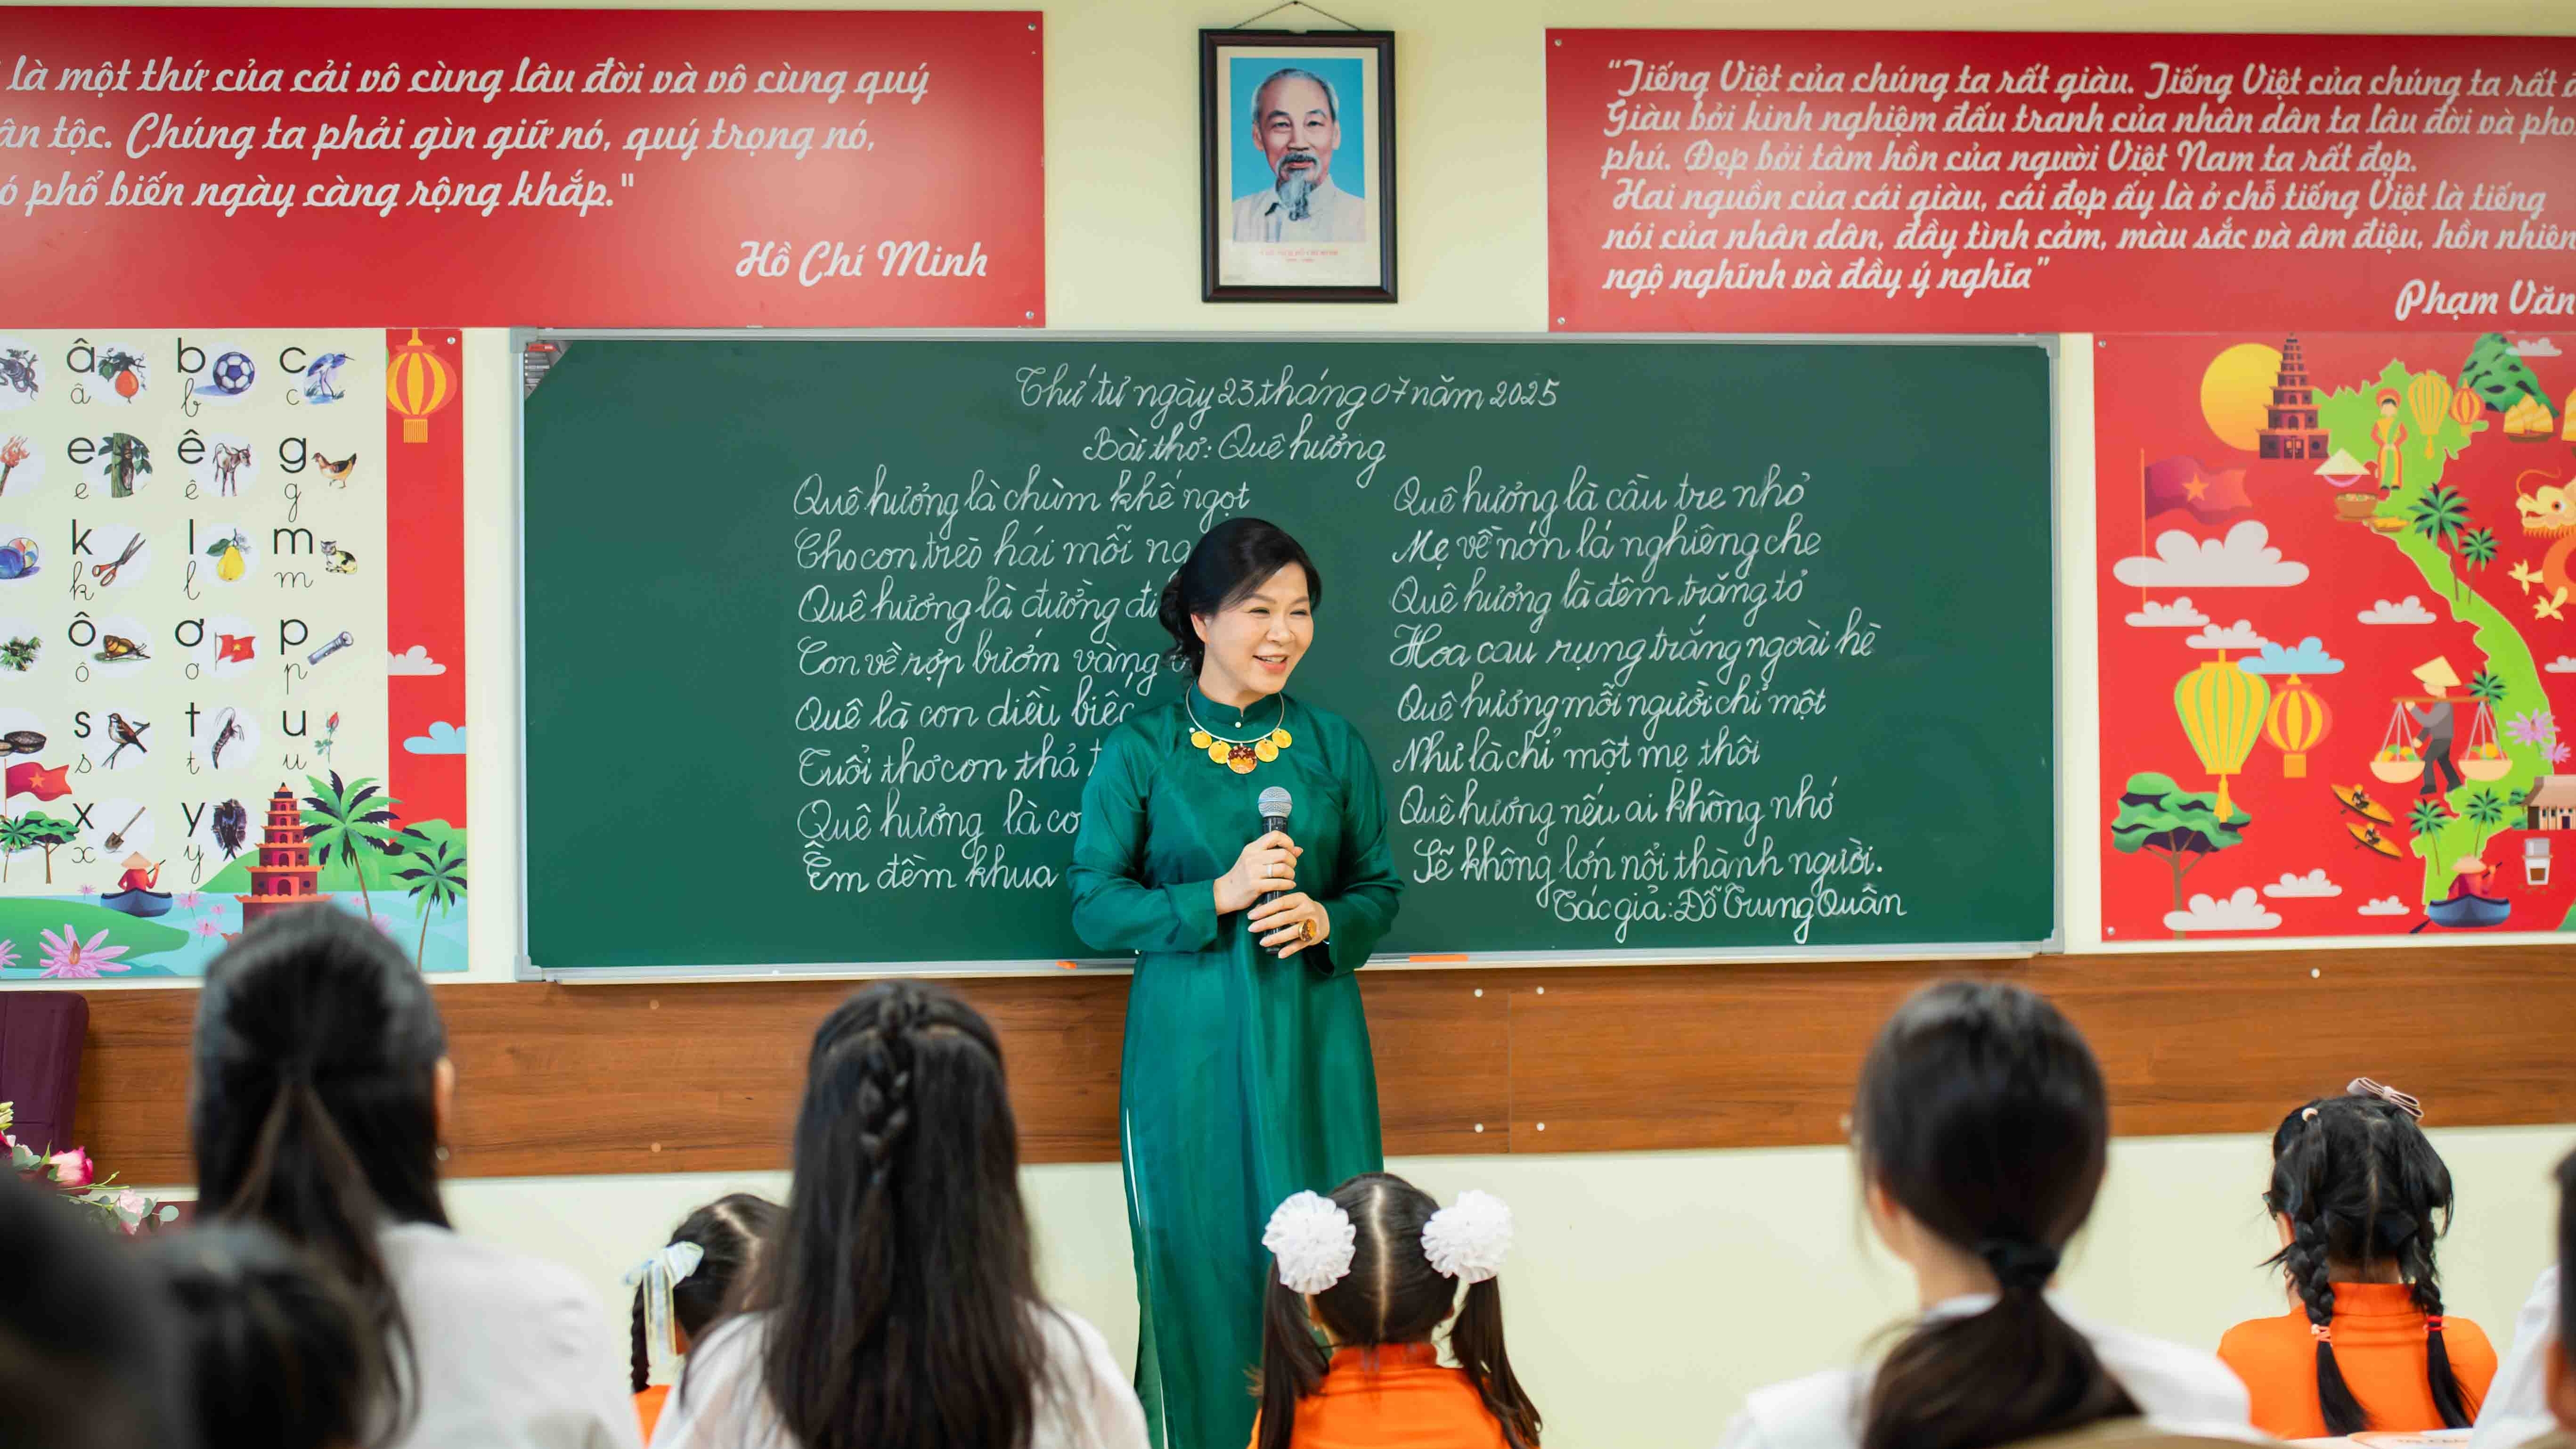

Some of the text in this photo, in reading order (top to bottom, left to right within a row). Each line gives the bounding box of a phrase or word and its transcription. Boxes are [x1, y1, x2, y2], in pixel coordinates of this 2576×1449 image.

[6, 55, 929, 105] là một thứ của cải vô cùng lâu đời và vô cùng quý
[1720, 60, 1782, 97] Việt
[1786, 63, 1845, 92] của
[1850, 62, 1949, 102] chúng
[1955, 65, 1991, 93] ta
[1997, 63, 2050, 93] rất
[2054, 66, 2134, 103] giàu.
[2144, 62, 2234, 104] Tiếng
[2242, 63, 2302, 100] Việt
[2306, 67, 2362, 95] của
[2368, 65, 2462, 105] chúng
[2467, 69, 2501, 96] ta
[2506, 68, 2557, 97] rất
[0, 113, 874, 161] ân tộc. Chúng ta phải gìn giữ nó, quý trọng nó,
[1601, 139, 2416, 182] phú. Đẹp bởi tâm hồn của người Việt Nam ta rất đẹp.
[25, 170, 104, 216] phổ
[106, 171, 184, 206] biến
[191, 175, 295, 217] ngày
[302, 175, 400, 217] càng
[406, 176, 502, 217] rộng
[508, 169, 613, 217] khắp.
[736, 241, 987, 287] Hồ Chí Minh
[1602, 263, 1663, 299] ngộ
[1670, 258, 1785, 299] nghĩnh
[1791, 261, 1833, 288] và
[1837, 257, 1902, 298] đầy
[1908, 261, 1931, 298] ý
[2395, 279, 2575, 321] Phạm Văn
[66, 338, 95, 373] â
[178, 337, 206, 374] b
[279, 347, 306, 374] c
[71, 383, 91, 404] â
[181, 377, 204, 418] b
[286, 389, 299, 405] c
[1016, 363, 1096, 408] Thứ
[1133, 377, 1215, 431] ngày
[1218, 377, 1254, 406] 23
[1254, 365, 1367, 431] tháng
[1371, 376, 1410, 404] 07
[1411, 375, 1484, 410] năm
[1490, 378, 1560, 407] 2025
[67, 437, 95, 464] e
[178, 429, 205, 465] ê
[279, 437, 306, 474] g
[1083, 426, 1147, 462] Bài
[1218, 423, 1285, 460] Quê
[74, 483, 89, 499] e
[185, 479, 199, 500] ê
[285, 483, 302, 523] g
[794, 473, 863, 516] Quê
[964, 469, 1000, 511] là
[1004, 464, 1101, 511] chùm
[1110, 469, 1182, 512] khế
[1183, 482, 1250, 534] ngọt
[1394, 476, 1458, 516] Quê
[1563, 465, 1598, 511] là
[1606, 474, 1667, 511] cầu
[1674, 473, 1726, 510] tre
[1733, 463, 1810, 508] nhỏ
[72, 519, 93, 555] k
[189, 519, 194, 555] l
[274, 528, 313, 555] m
[1392, 512, 1821, 585] Mẹ về nón lá nghiêng che
[69, 561, 94, 600] k
[184, 560, 200, 600] l
[274, 572, 313, 588] m
[68, 611, 96, 647] ô
[175, 618, 204, 647] ơ
[280, 619, 308, 655] p
[1390, 606, 1881, 689] Hoa cau rụng trắng ngoài hè
[75, 662, 89, 682] ô
[186, 663, 199, 679] ơ
[284, 663, 308, 695] p
[74, 711, 91, 738] s
[185, 702, 201, 737] t
[283, 710, 306, 737] u
[795, 696, 863, 731] Quê
[869, 689, 912, 729] là
[920, 705, 979, 728] con
[987, 685, 1060, 727] diều
[74, 753, 92, 773] s
[187, 751, 200, 775] t
[283, 754, 307, 770] u
[1468, 727, 1504, 772] là
[1506, 726, 1562, 770] chỉ
[1563, 735, 1631, 775] một
[1638, 744, 1688, 773] mẹ
[1698, 725, 1760, 766] thôi
[72, 803, 94, 831] x
[181, 802, 206, 837] y
[72, 847, 96, 863] x
[183, 844, 204, 884] y
[1553, 882, 1907, 943] Tác giả: Đỗ Trung Quân
